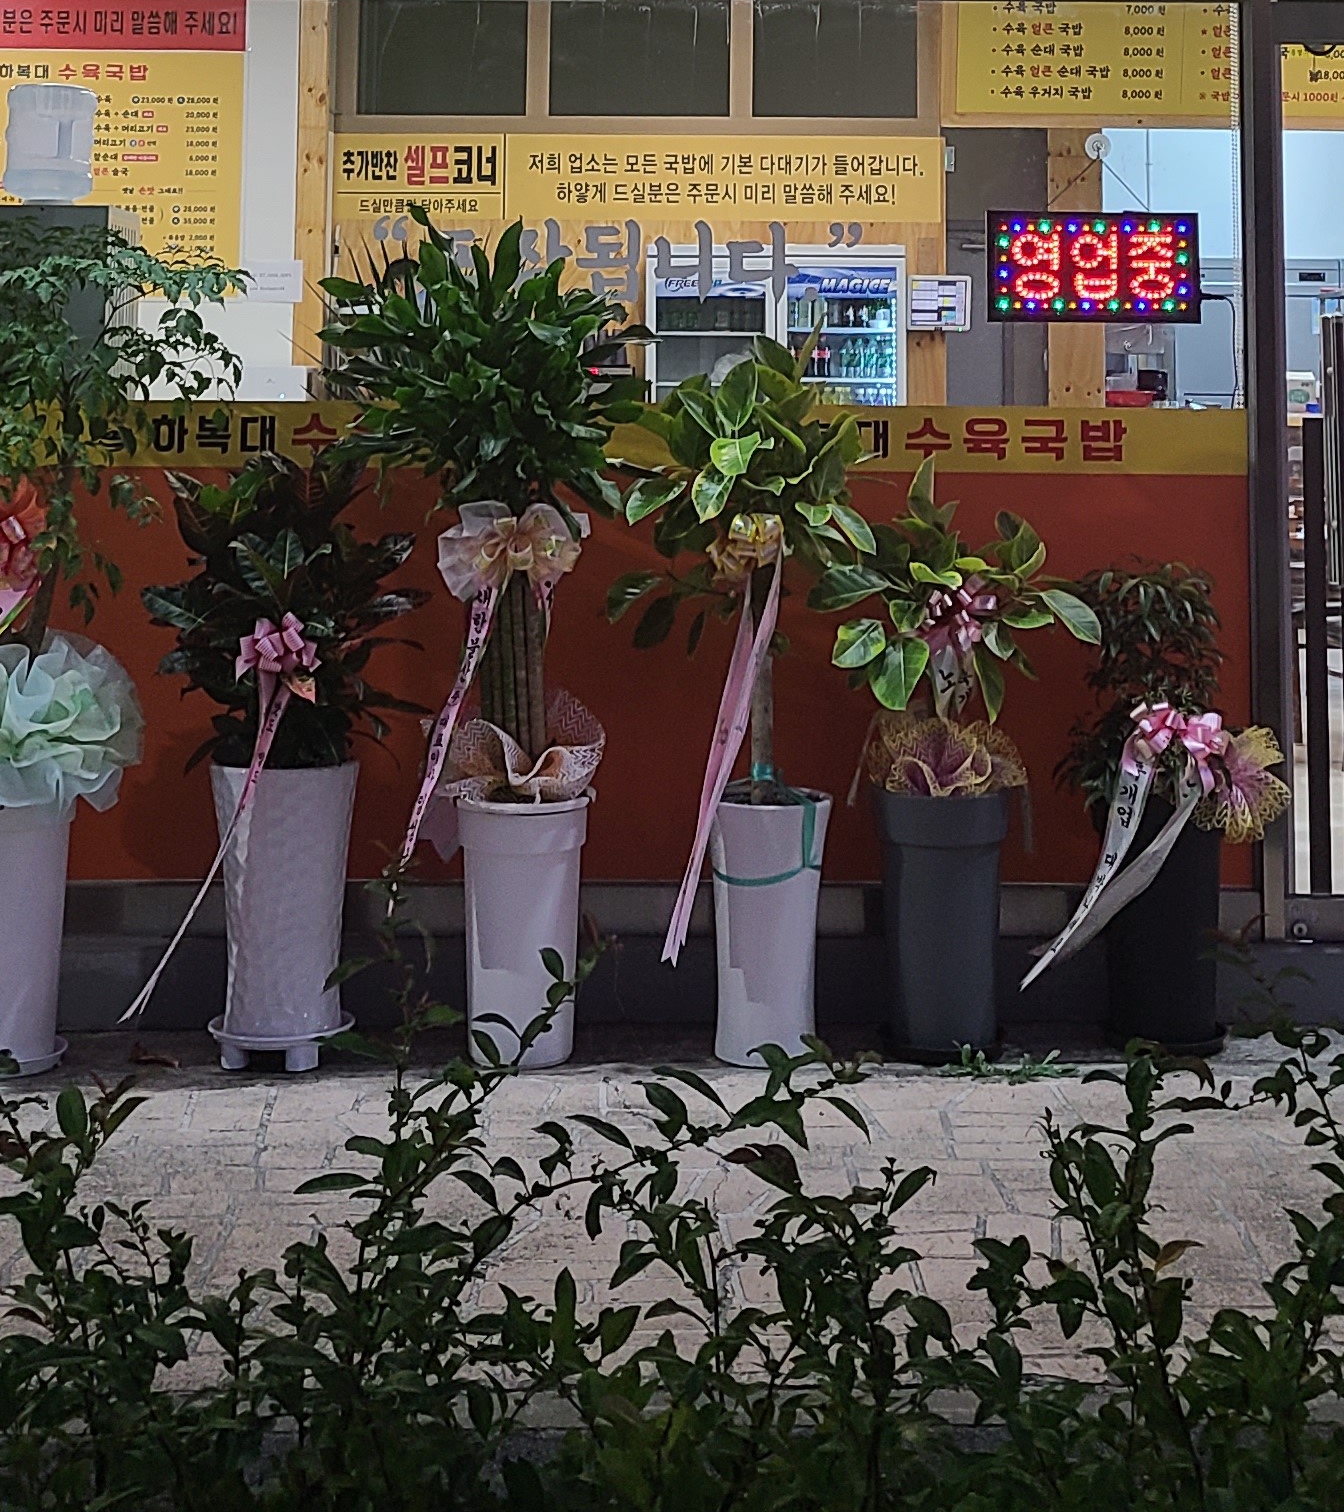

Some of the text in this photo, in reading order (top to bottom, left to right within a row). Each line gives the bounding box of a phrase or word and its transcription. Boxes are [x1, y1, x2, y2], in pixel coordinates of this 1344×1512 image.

[1125, 4, 1154, 17] 7,000
[39, 9, 87, 35] 주문시
[93, 10, 125, 36] 미리
[130, 10, 178, 36] 말씀해
[183, 10, 238, 37] 주세요!
[1002, 21, 1028, 36] 수육
[1031, 21, 1055, 36] 얼큰
[1058, 22, 1084, 36] 국밥
[1124, 25, 1154, 37] 8,000
[1001, 42, 1027, 57] 수육
[1030, 43, 1056, 57] 순대
[1059, 44, 1084, 58] 국밥
[1123, 47, 1153, 59] 8,000
[57, 62, 150, 82] 수육국밥
[1000, 64, 1027, 78] 수육
[1029, 64, 1054, 78] 얼큰
[1056, 64, 1082, 79] 순대
[1085, 65, 1111, 80] 국밥
[1122, 68, 1152, 80] 8,000
[999, 85, 1025, 100] 수육
[1028, 85, 1064, 100] 우거지
[1067, 86, 1093, 101] 국밥
[1121, 89, 1152, 101] 8,000
[1303, 91, 1339, 103] 1000원
[342, 144, 498, 187] 추가반찬 셀프코너
[527, 152, 925, 177] 저희 업소는 모든 국밥에 기본 다대기가 들어갑니다.
[612, 181, 682, 204] 드실분은
[686, 182, 737, 205] 주문시
[743, 182, 776, 205] 미리
[782, 182, 834, 206] 말씀해
[838, 183, 897, 206] 주세요!
[1011, 232, 1176, 300] 영업중
[818, 277, 892, 295] MAGICE
[151, 413, 277, 455] 하복대
[904, 417, 1127, 463] 수육국밥
